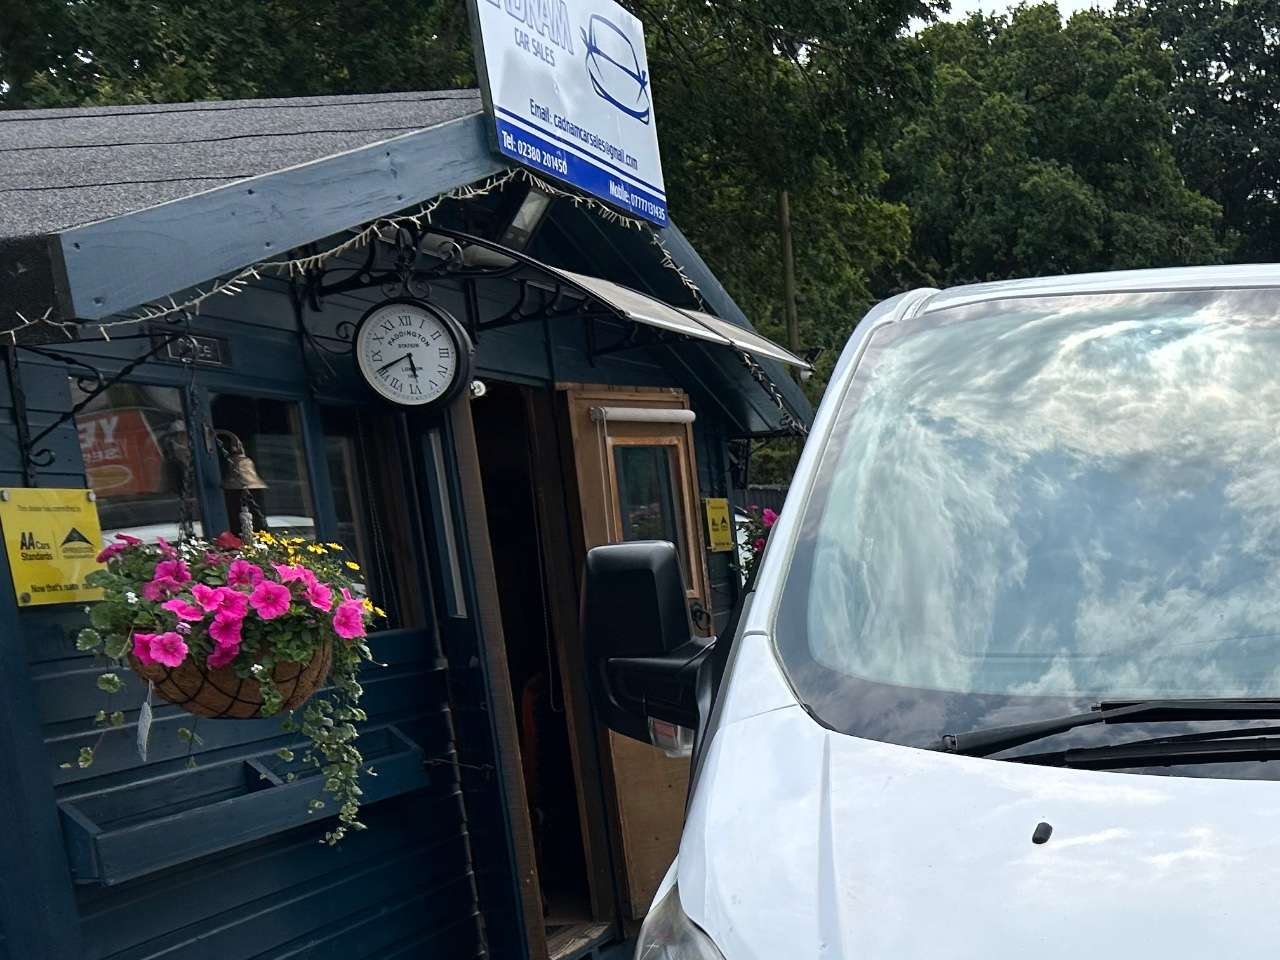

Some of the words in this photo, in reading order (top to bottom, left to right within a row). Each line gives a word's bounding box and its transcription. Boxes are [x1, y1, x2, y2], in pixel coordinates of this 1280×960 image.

[486, 0, 574, 55] NAM
[514, 26, 530, 52] CAR
[531, 37, 555, 67] SALES
[529, 98, 552, 125] Email:
[501, 130, 517, 152] Tel:
[517, 139, 541, 163] 02380
[542, 151, 568, 175] 201450
[387, 330, 431, 347] PADDINGTON
[20, 532, 35, 550] AA
